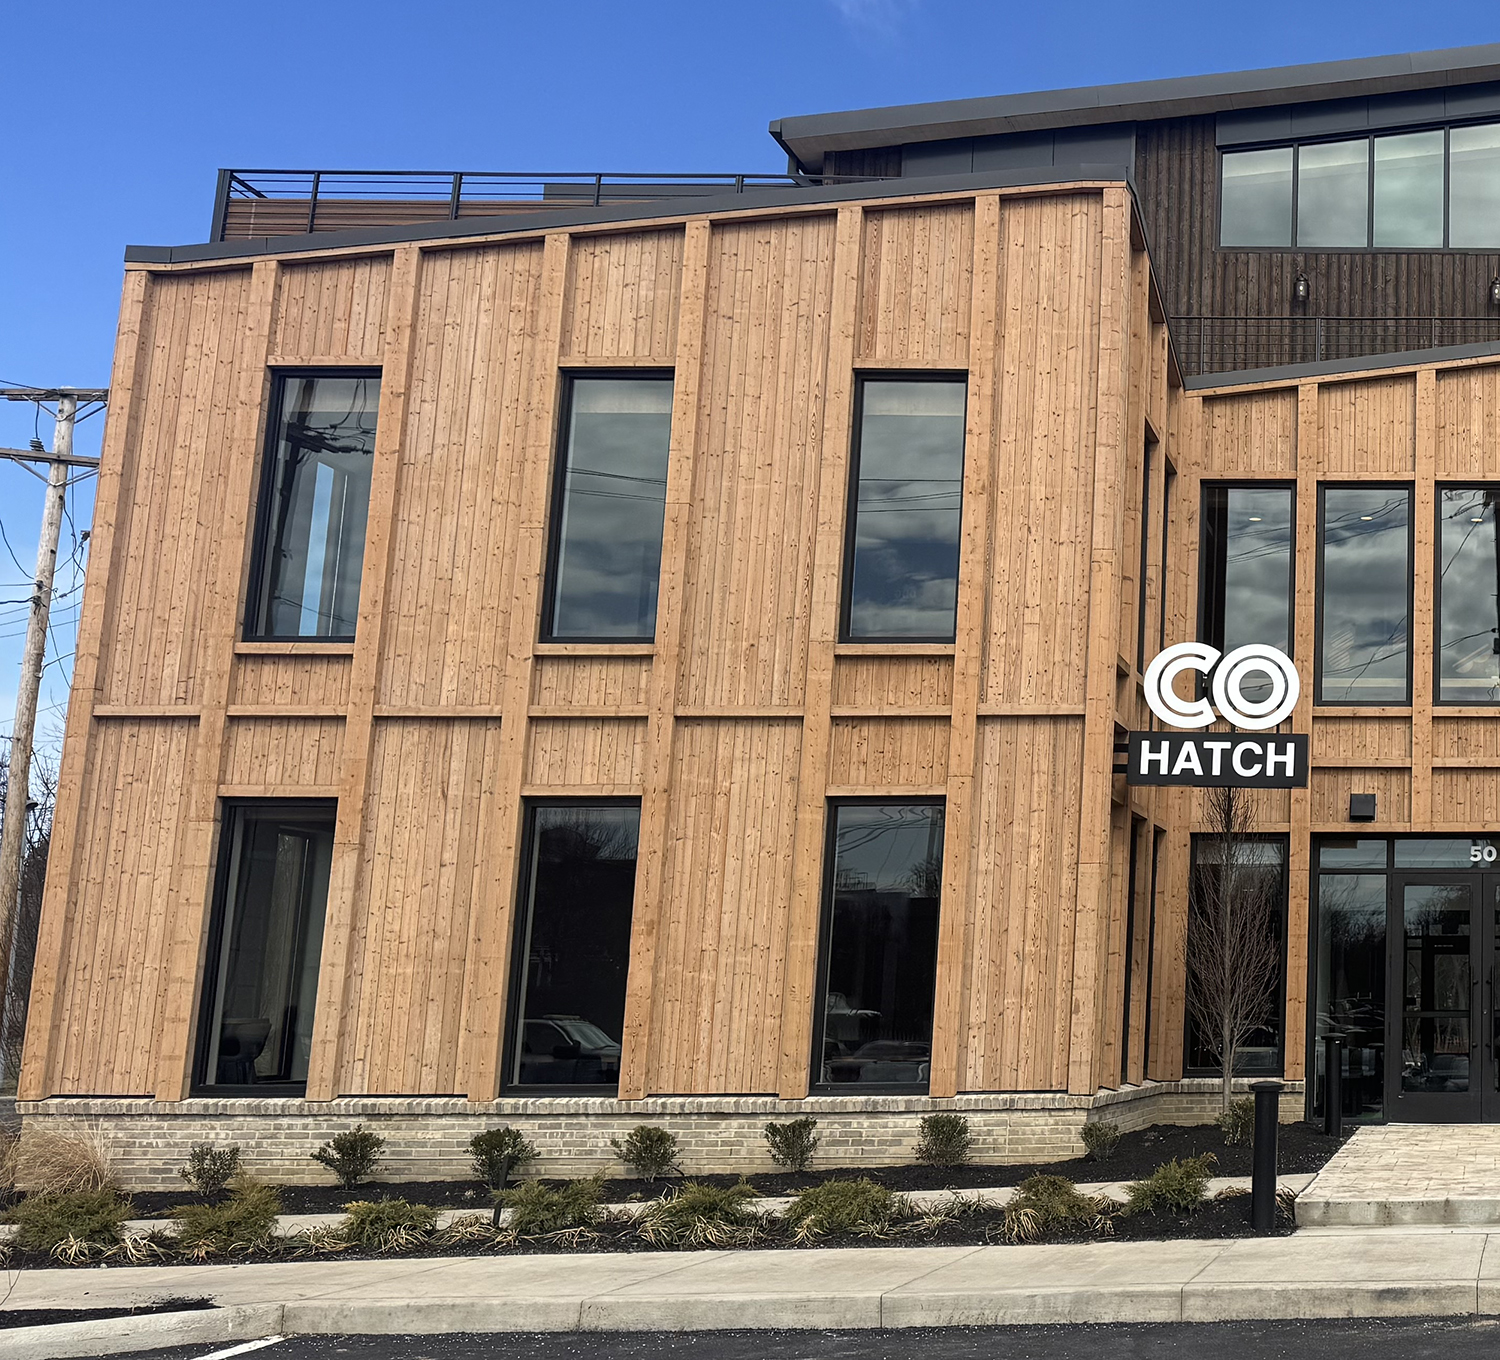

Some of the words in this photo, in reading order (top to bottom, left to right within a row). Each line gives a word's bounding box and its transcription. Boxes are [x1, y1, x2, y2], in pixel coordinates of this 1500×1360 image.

[1143, 642, 1300, 730] CO
[1139, 740, 1296, 777] HATCH
[1469, 845, 1498, 862] 50
